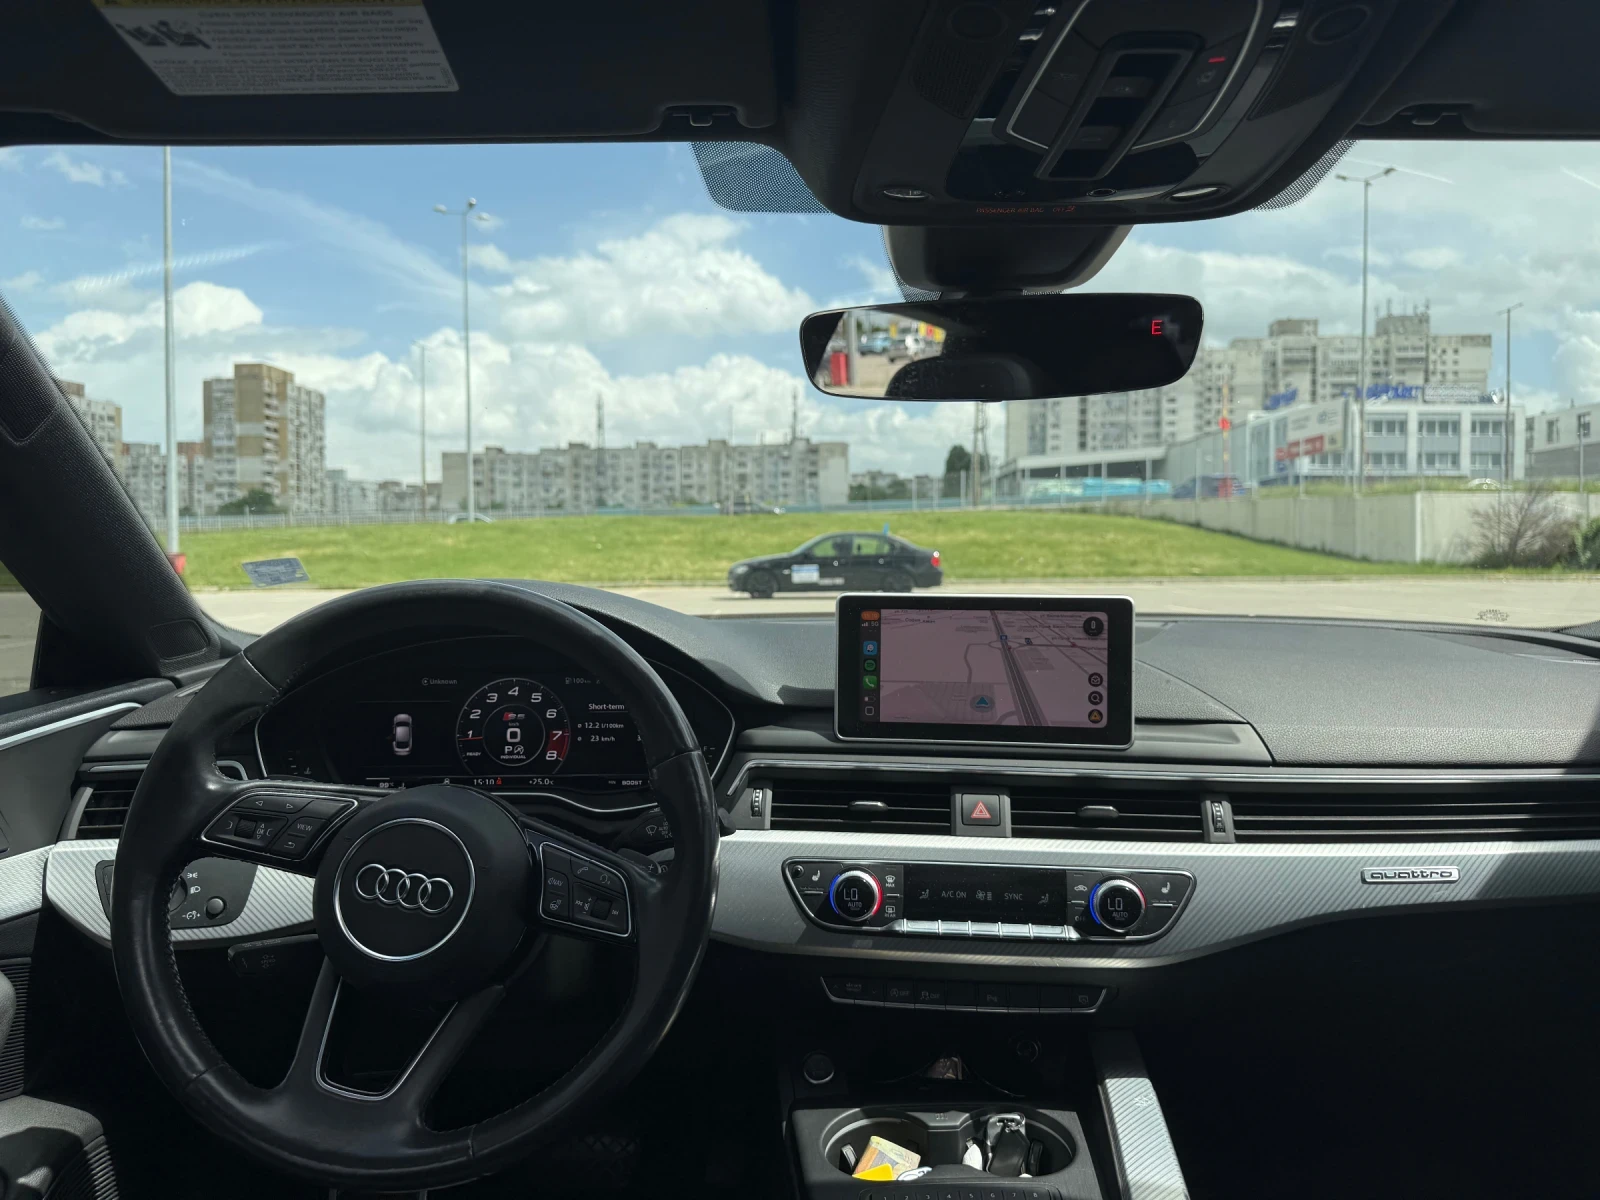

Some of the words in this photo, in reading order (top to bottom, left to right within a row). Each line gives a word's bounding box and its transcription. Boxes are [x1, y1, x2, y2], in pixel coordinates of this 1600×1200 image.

[1151, 319, 1163, 335] E
[507, 686, 520, 696] 4
[485, 692, 499, 703] 3
[530, 692, 543, 703] 5
[469, 709, 482, 719] 2
[545, 708, 558, 719] 6
[467, 729, 474, 739] 1
[552, 730, 563, 741] 7
[504, 745, 513, 754] P
[545, 750, 557, 761] 8
[297, 823, 313, 832] VIEW
[1370, 869, 1453, 880] quattro
[843, 887, 858, 901] LO
[941, 890, 955, 898] A/C
[955, 891, 967, 899] ON
[1003, 892, 1023, 901] SYNC
[1107, 897, 1123, 911] LO
